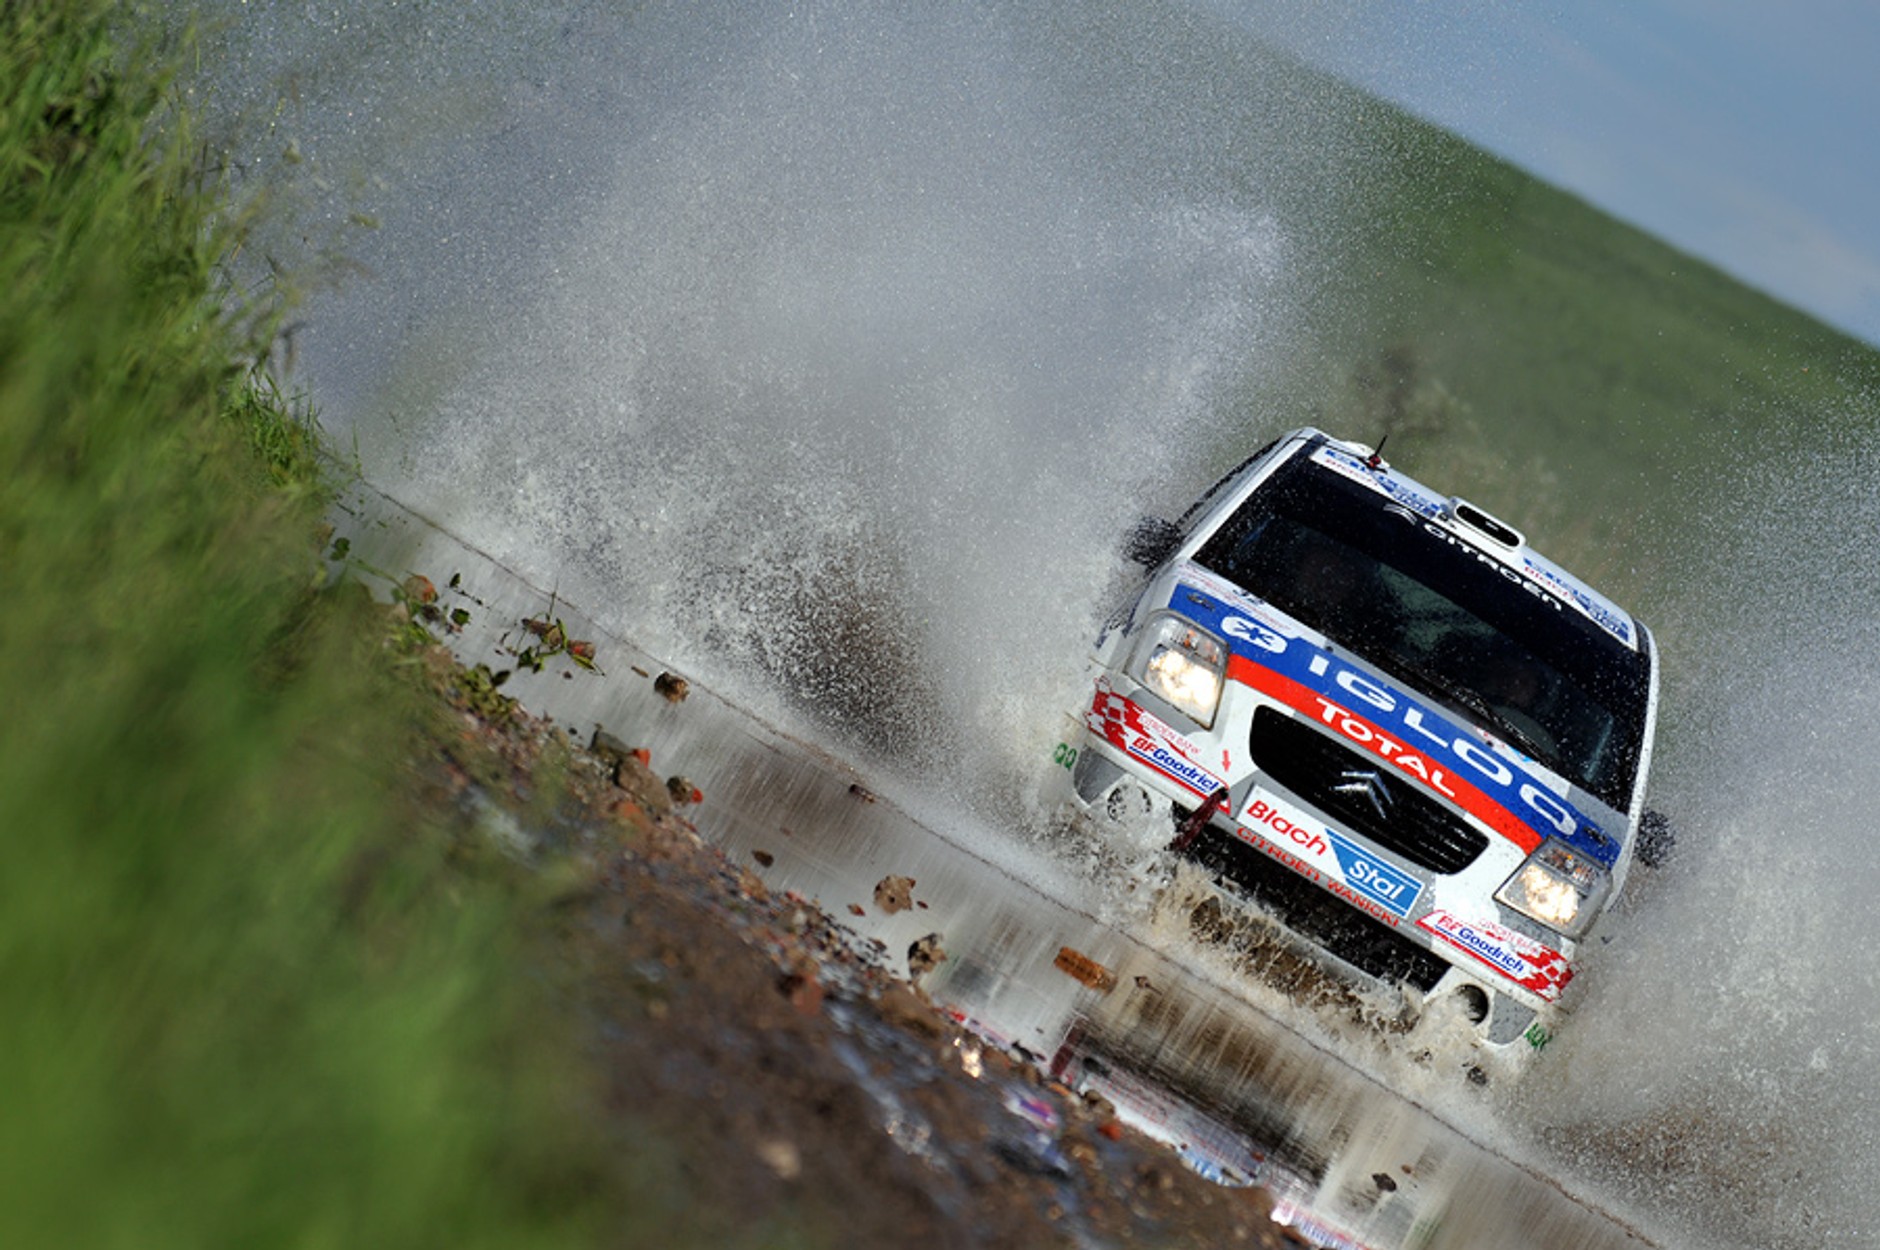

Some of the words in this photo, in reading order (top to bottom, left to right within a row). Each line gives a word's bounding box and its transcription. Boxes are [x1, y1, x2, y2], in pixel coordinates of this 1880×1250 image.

[1307, 655, 1577, 835] IGLOO
[1316, 697, 1455, 797] TOTAL
[1247, 800, 1328, 856] Blach
[1350, 860, 1405, 900] Stal
[1328, 880, 1399, 928] WANICKI
[1437, 914, 1525, 974] BFGoodrich
